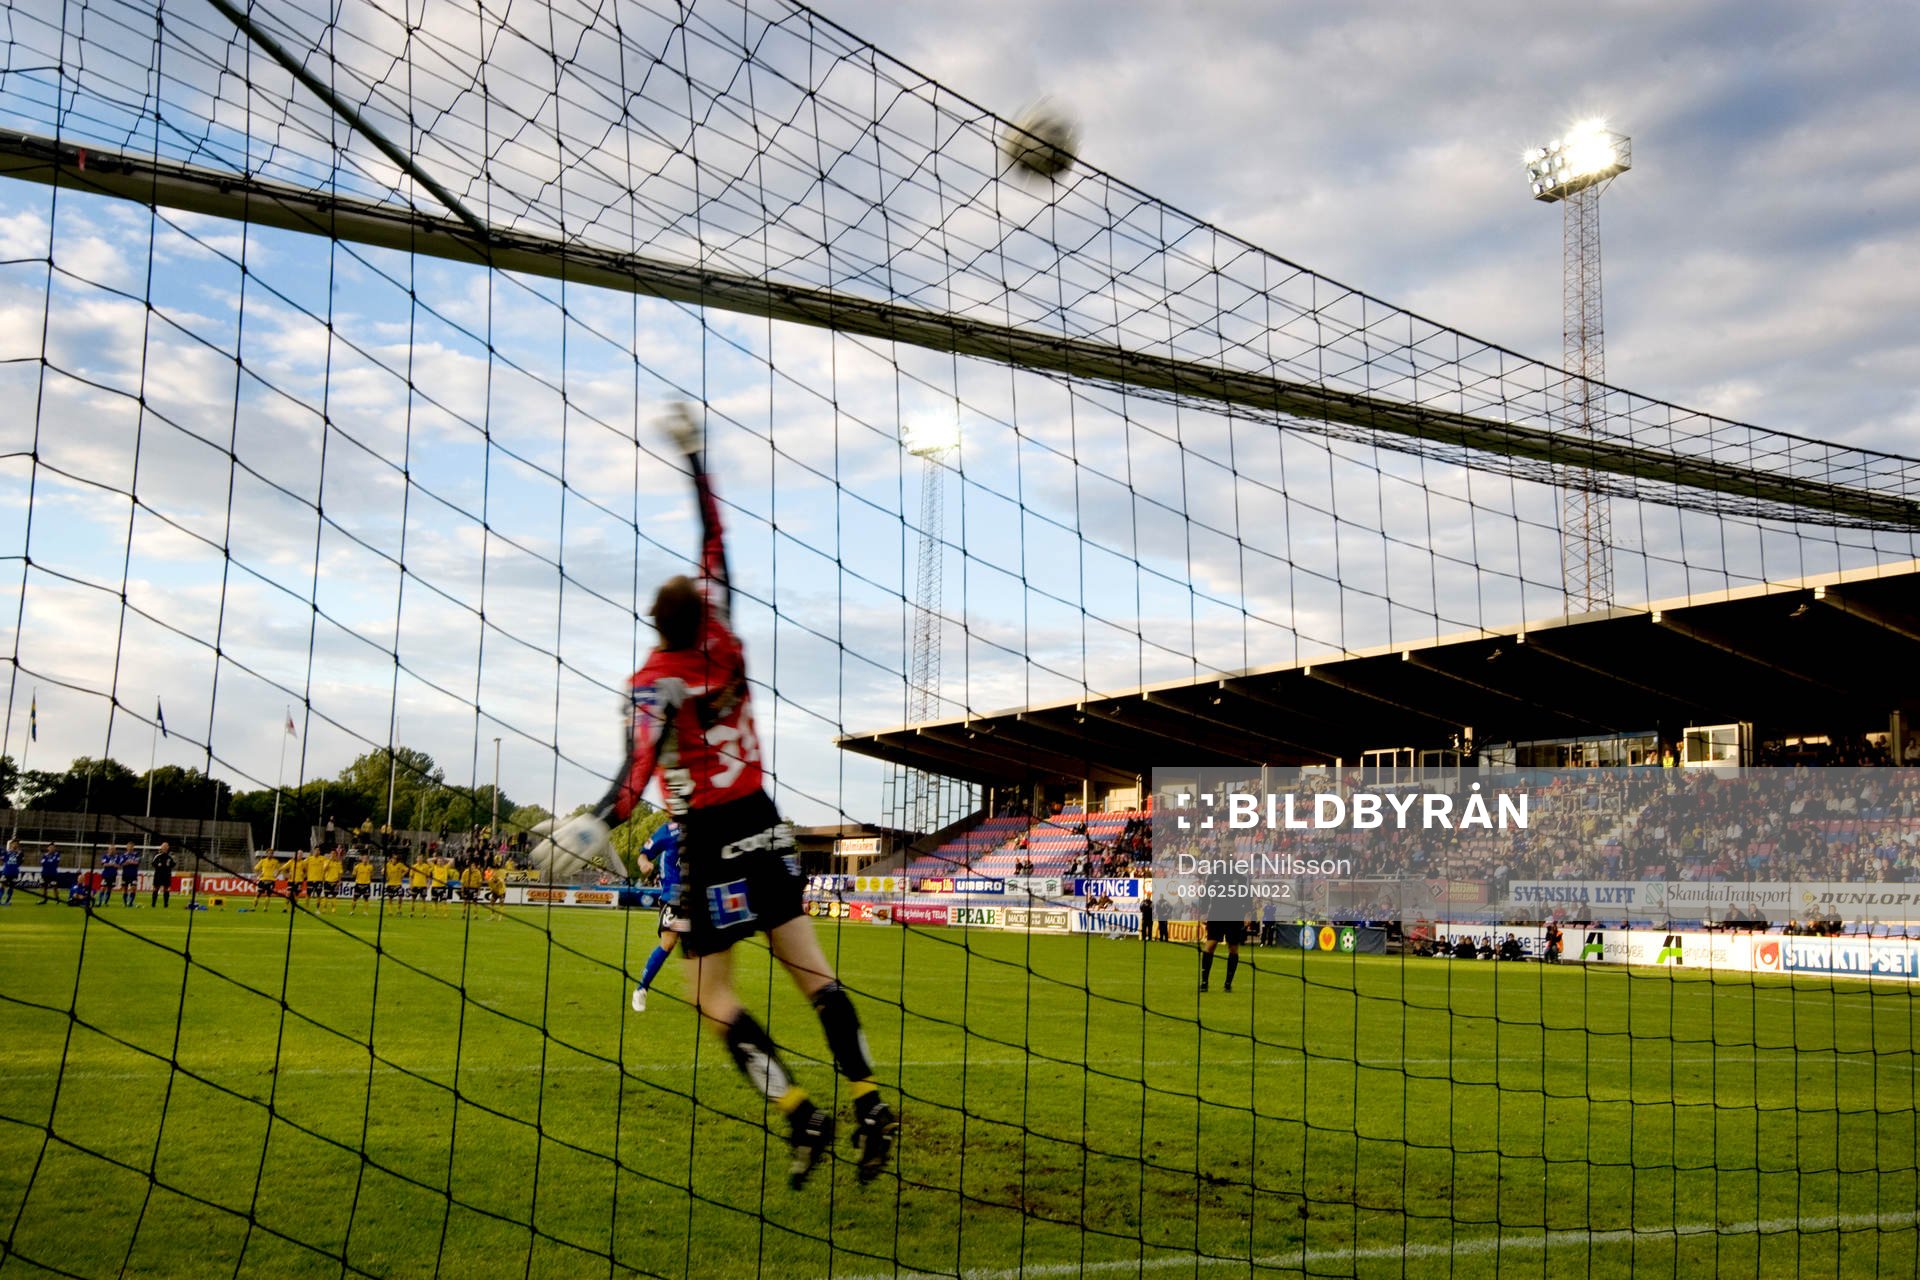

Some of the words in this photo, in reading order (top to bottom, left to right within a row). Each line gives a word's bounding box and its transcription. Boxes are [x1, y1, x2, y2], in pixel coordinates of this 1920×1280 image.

[956, 880, 1003, 891] UMBRO
[1082, 879, 1130, 896] GETINGE
[1514, 886, 1590, 902] SVENSKA
[1595, 887, 1636, 903] LYFT
[1819, 892, 1911, 905] DUNLOP
[957, 908, 995, 924] PEAB
[1785, 943, 1914, 974] STRYKTIPSET
